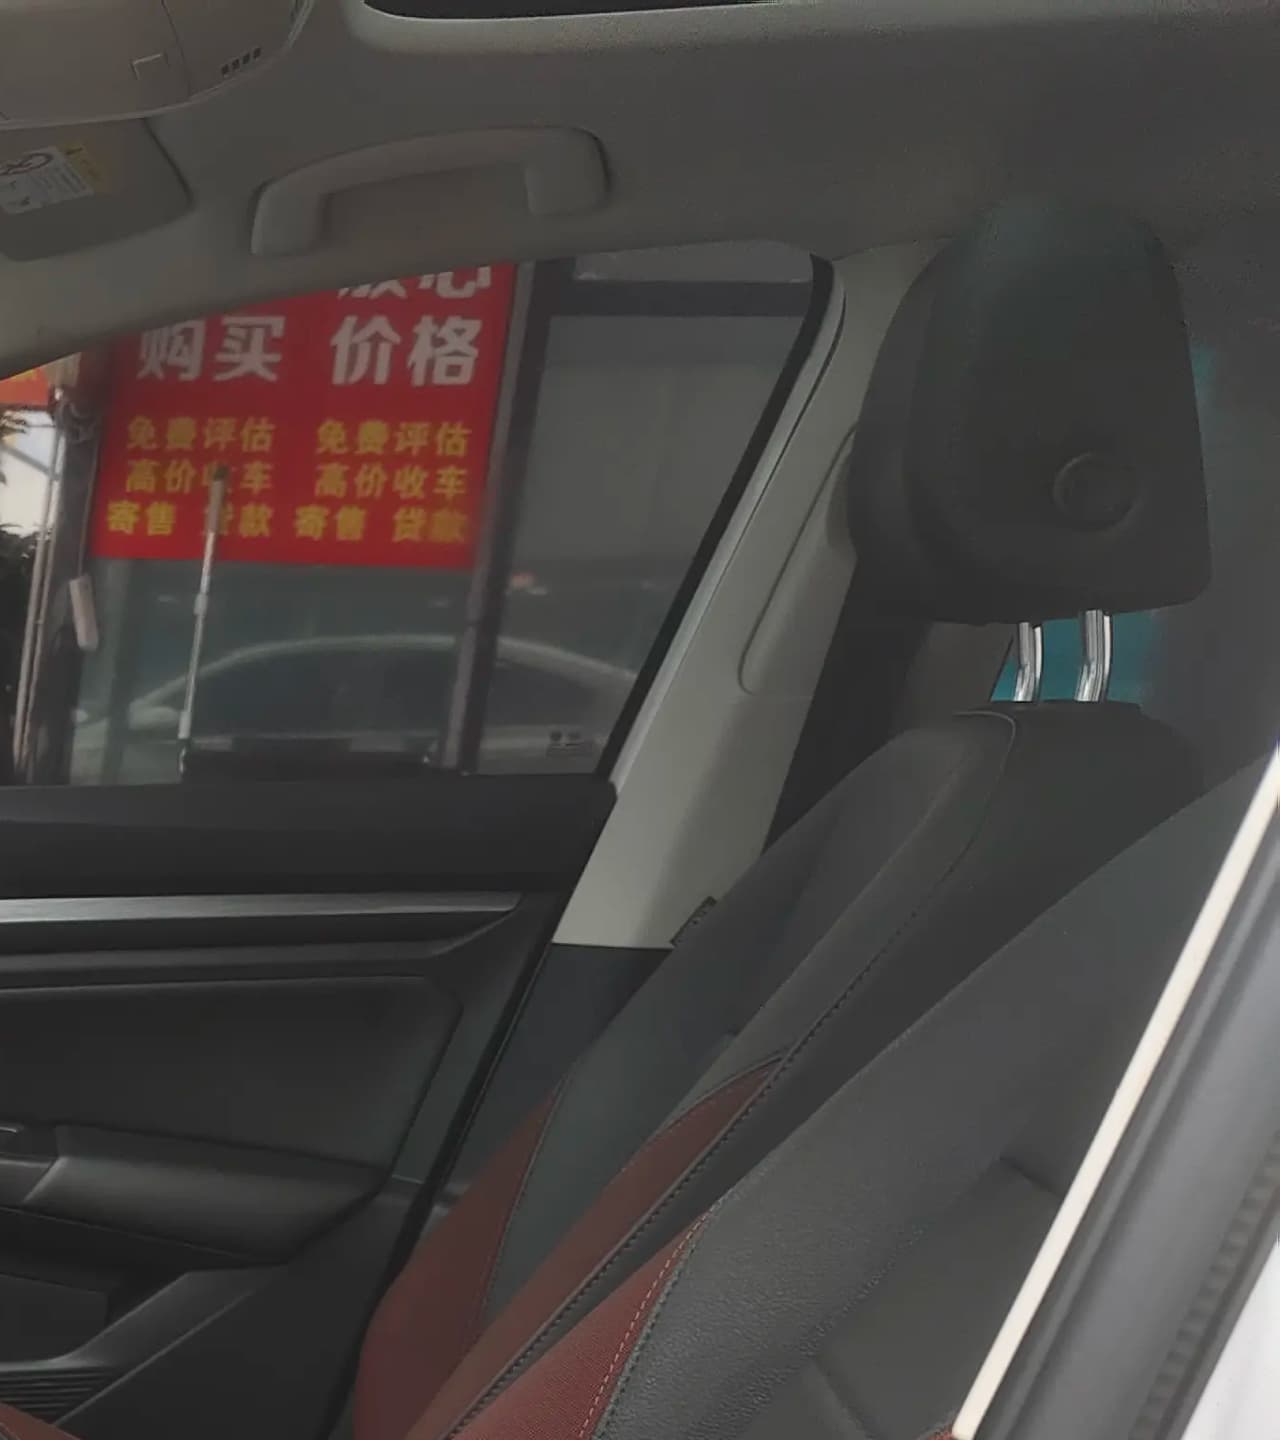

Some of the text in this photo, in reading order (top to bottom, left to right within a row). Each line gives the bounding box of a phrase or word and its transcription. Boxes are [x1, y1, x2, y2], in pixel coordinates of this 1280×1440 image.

[138, 313, 483, 386] 购买 价格
[126, 415, 473, 457] 免费评估 免费评估
[314, 461, 469, 501] 高价收车
